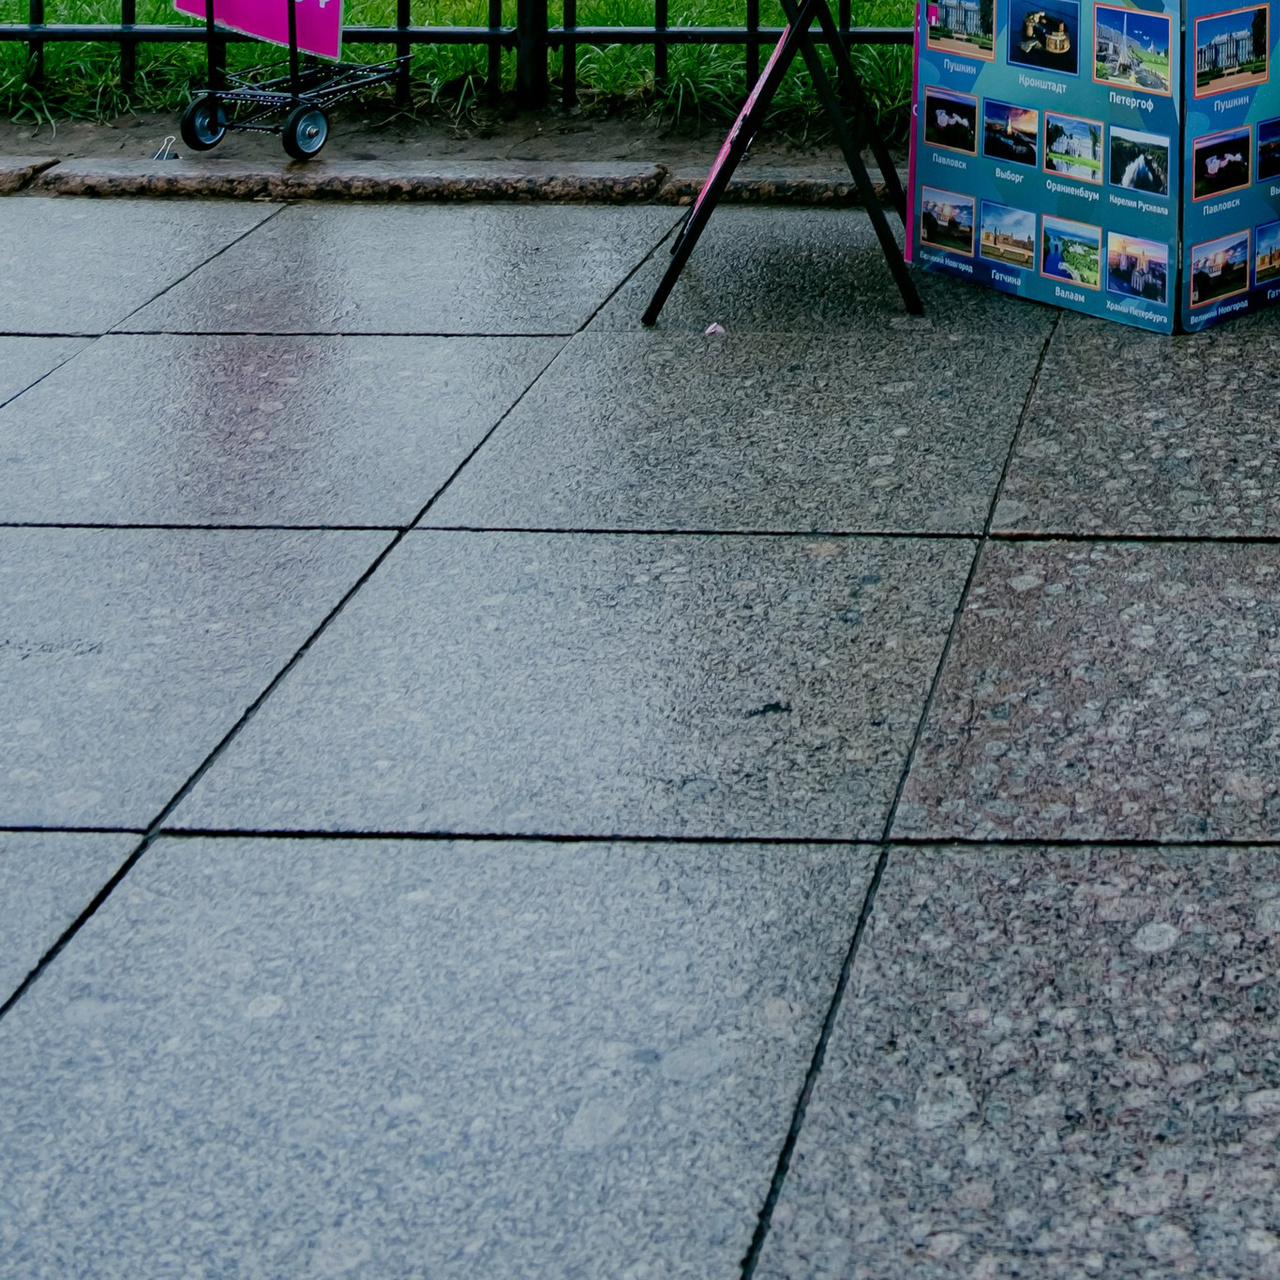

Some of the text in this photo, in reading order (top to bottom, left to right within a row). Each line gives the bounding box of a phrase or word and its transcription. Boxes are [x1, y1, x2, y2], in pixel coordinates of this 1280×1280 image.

[943, 58, 976, 75] Пушкин
[1018, 73, 1067, 94] Кронштадт
[1109, 91, 1154, 113] Петергоф
[1214, 95, 1250, 113] Пушкин
[932, 153, 967, 170] Павловск
[995, 167, 1024, 184] Выборг
[1046, 179, 1100, 201] Ораниенбаум
[1109, 193, 1169, 216] Карелия Рускеала
[1203, 197, 1241, 216] Павловск
[991, 269, 1022, 287] Гатчина
[1055, 286, 1086, 303] Валаам
[1106, 299, 1168, 324] Храмы Петербурга
[1218, 299, 1249, 316] Новгород
